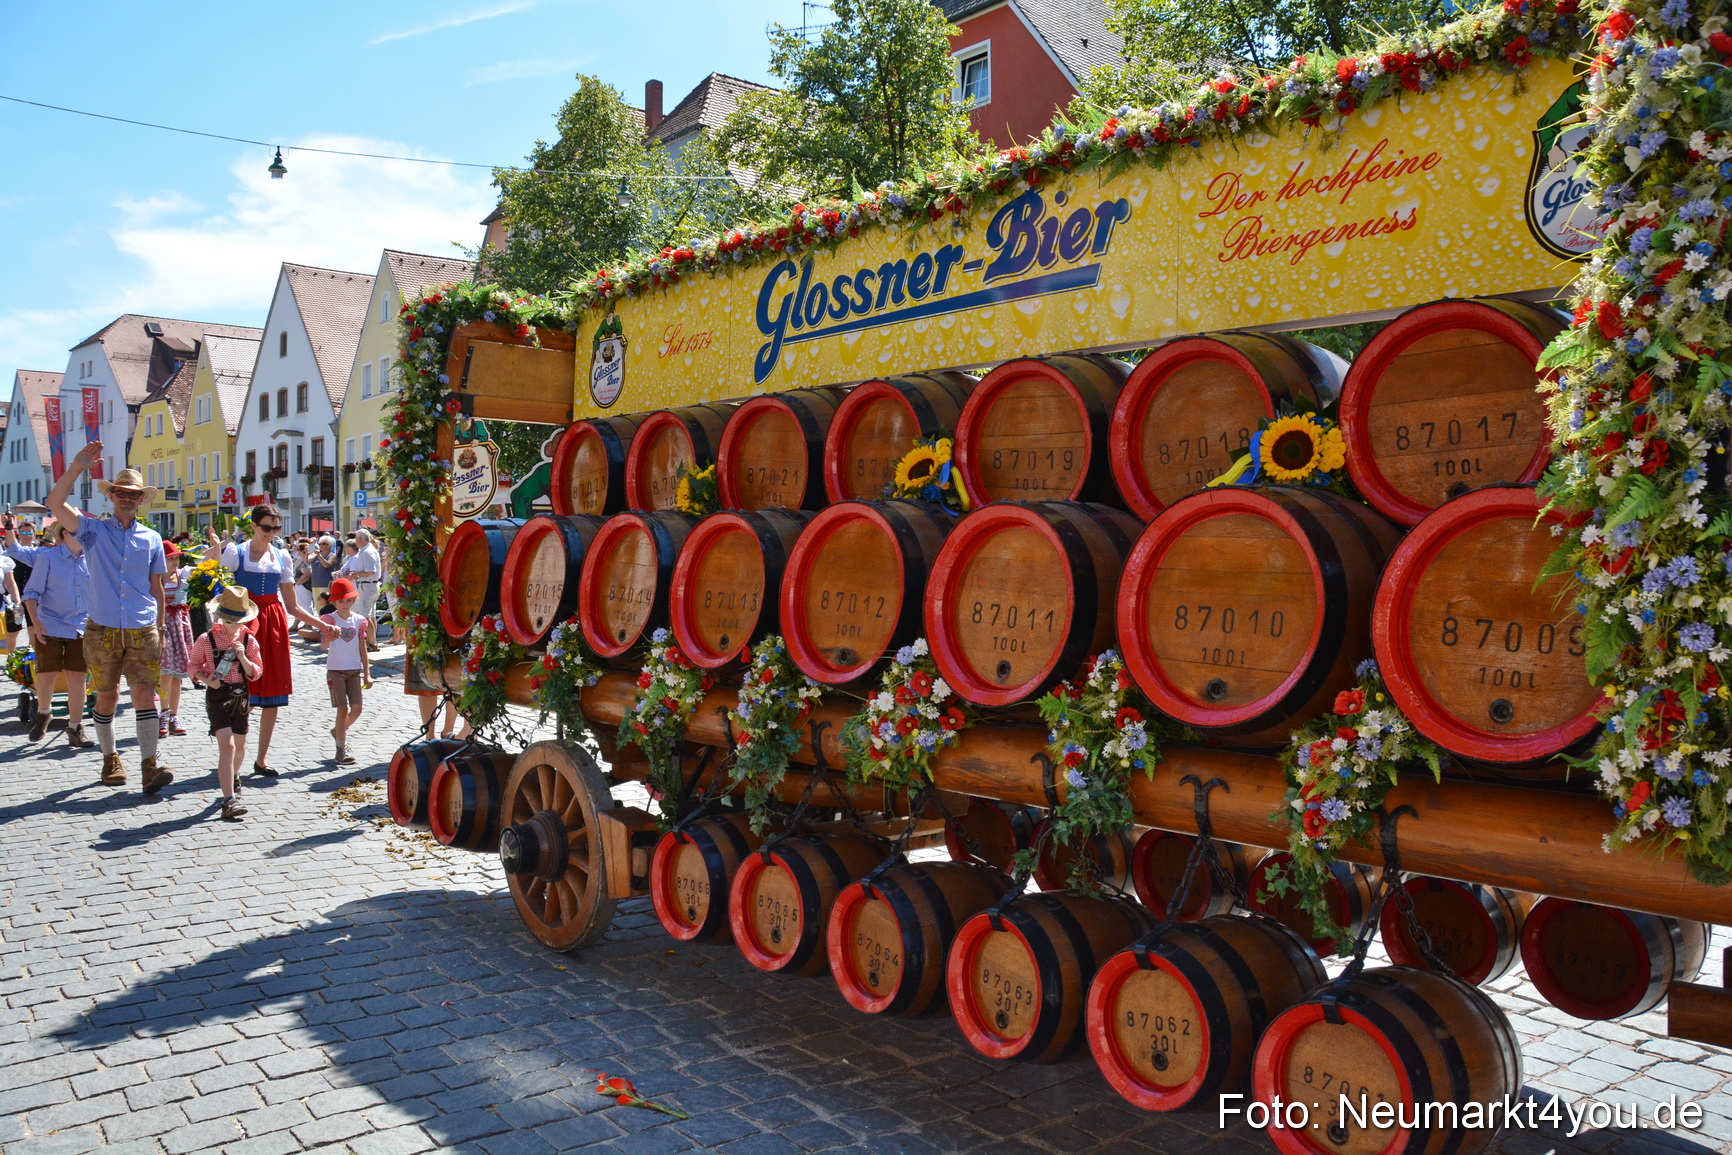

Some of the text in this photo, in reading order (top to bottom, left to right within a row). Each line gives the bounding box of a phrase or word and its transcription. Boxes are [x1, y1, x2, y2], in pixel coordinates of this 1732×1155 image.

[1198, 138, 1441, 218] Der hochfeine
[1542, 175, 1600, 226] Glos
[1218, 207, 1417, 265] Biergenuss
[754, 187, 1132, 384] Glossner-Bier
[658, 323, 713, 358] Seit 1574
[85, 391, 93, 413] K&L
[1396, 413, 1517, 450] 87017
[993, 449, 1073, 470] 87019
[1159, 428, 1250, 464] 87018
[469, 480, 490, 494] Bier
[747, 467, 799, 486] 87021
[357, 493, 364, 506] P
[527, 579, 564, 600] 87015
[608, 584, 653, 606] 87014
[704, 590, 760, 612] 87013
[820, 590, 885, 618] 87012
[972, 602, 1055, 633] 87011
[1175, 605, 1284, 638] 87010
[677, 877, 710, 894] 87066
[758, 895, 798, 921] 87065
[857, 933, 899, 967] 87064
[982, 969, 1033, 1006] 87063
[1126, 1011, 1190, 1036] 87062
